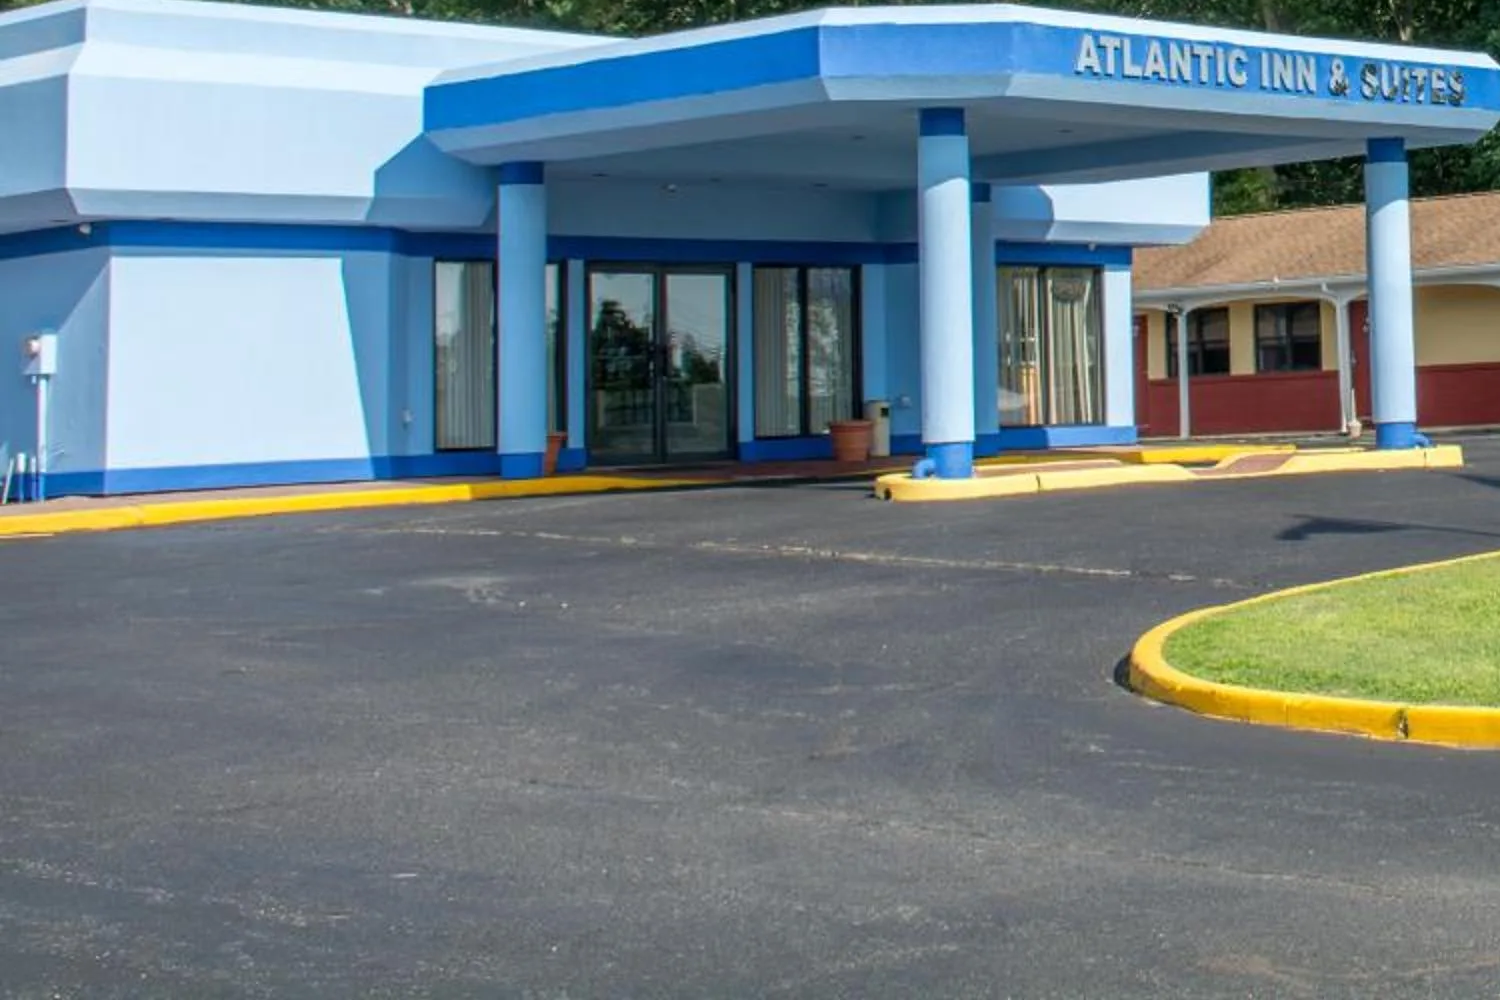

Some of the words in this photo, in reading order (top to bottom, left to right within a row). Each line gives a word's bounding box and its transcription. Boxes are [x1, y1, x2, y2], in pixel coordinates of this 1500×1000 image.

[1075, 33, 1248, 88] ATLANTIC
[1259, 51, 1317, 94] INN
[1328, 57, 1348, 96] &
[1360, 62, 1465, 106] SUITES
